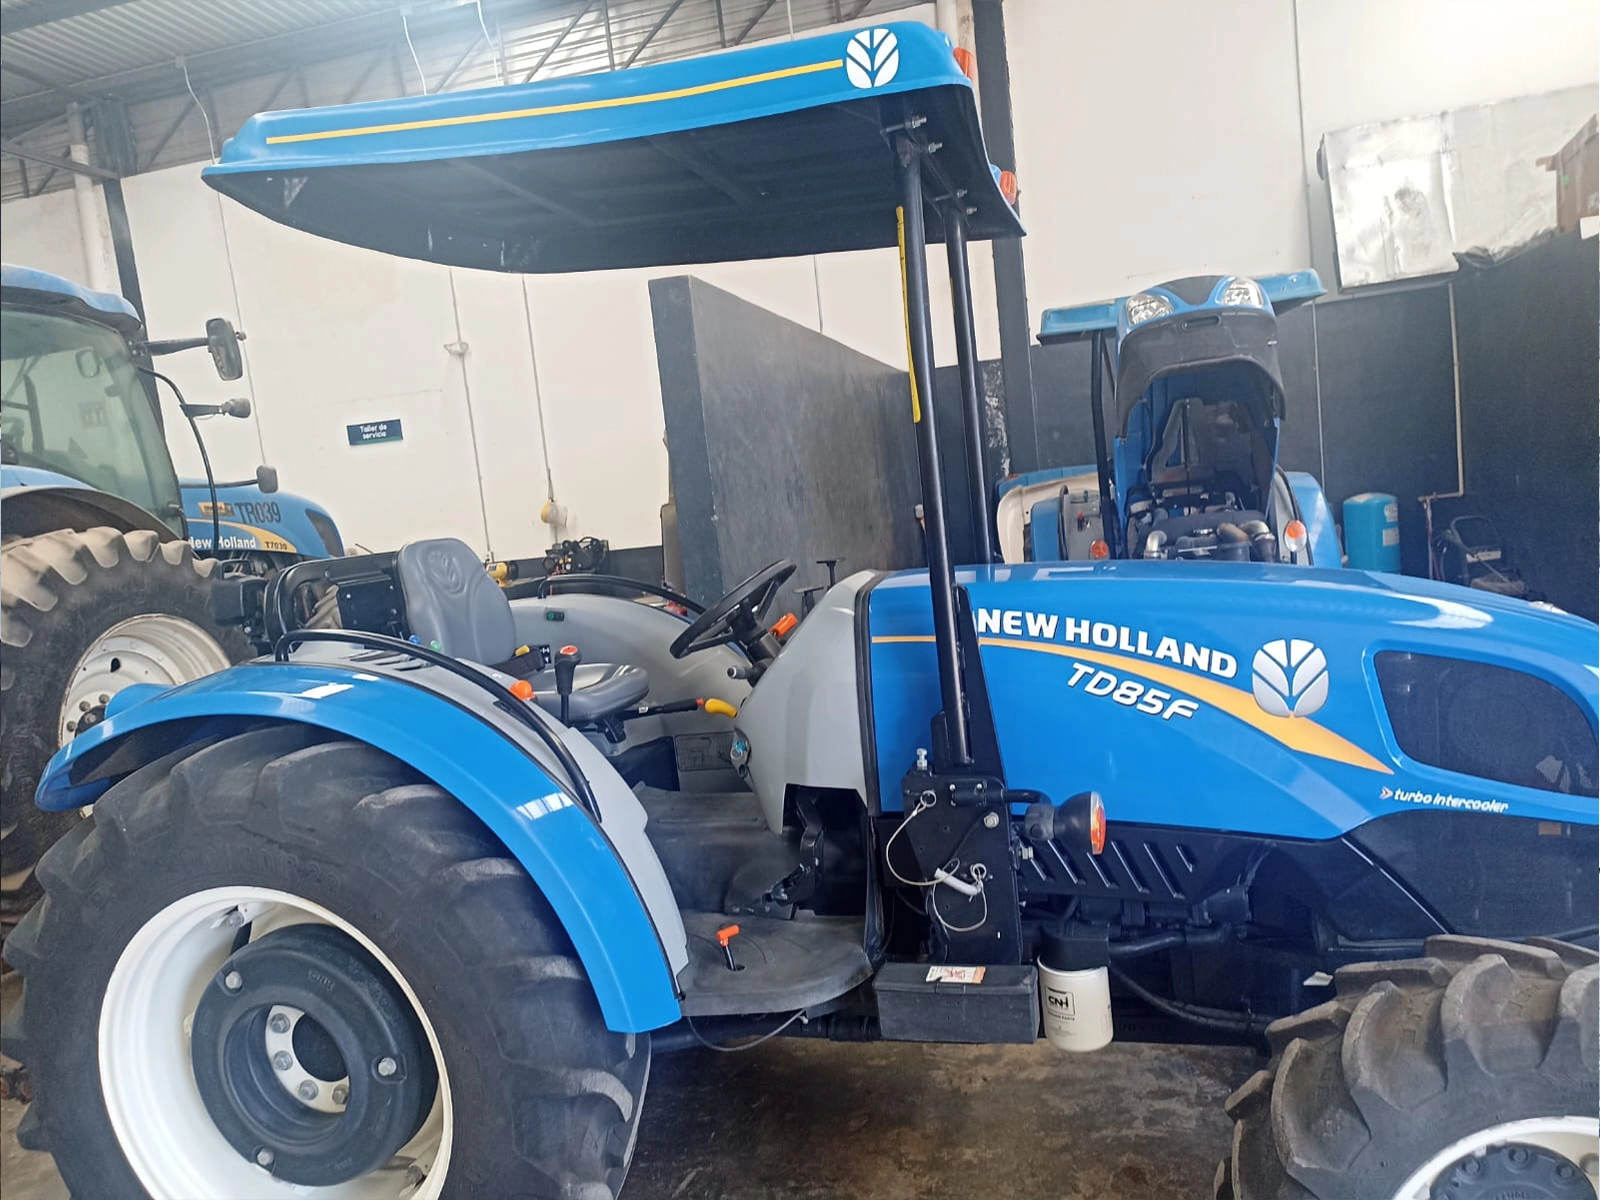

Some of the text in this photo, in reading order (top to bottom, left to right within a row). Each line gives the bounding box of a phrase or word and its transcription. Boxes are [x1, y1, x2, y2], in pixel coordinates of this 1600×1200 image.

[360, 424, 377, 432] Taller
[362, 431, 386, 439] servicio
[235, 501, 281, 524] TR039
[977, 608, 1238, 679] NEW HOLLAND
[1067, 662, 1199, 720] TD85F
[1394, 788, 1509, 813] turbo intercooler
